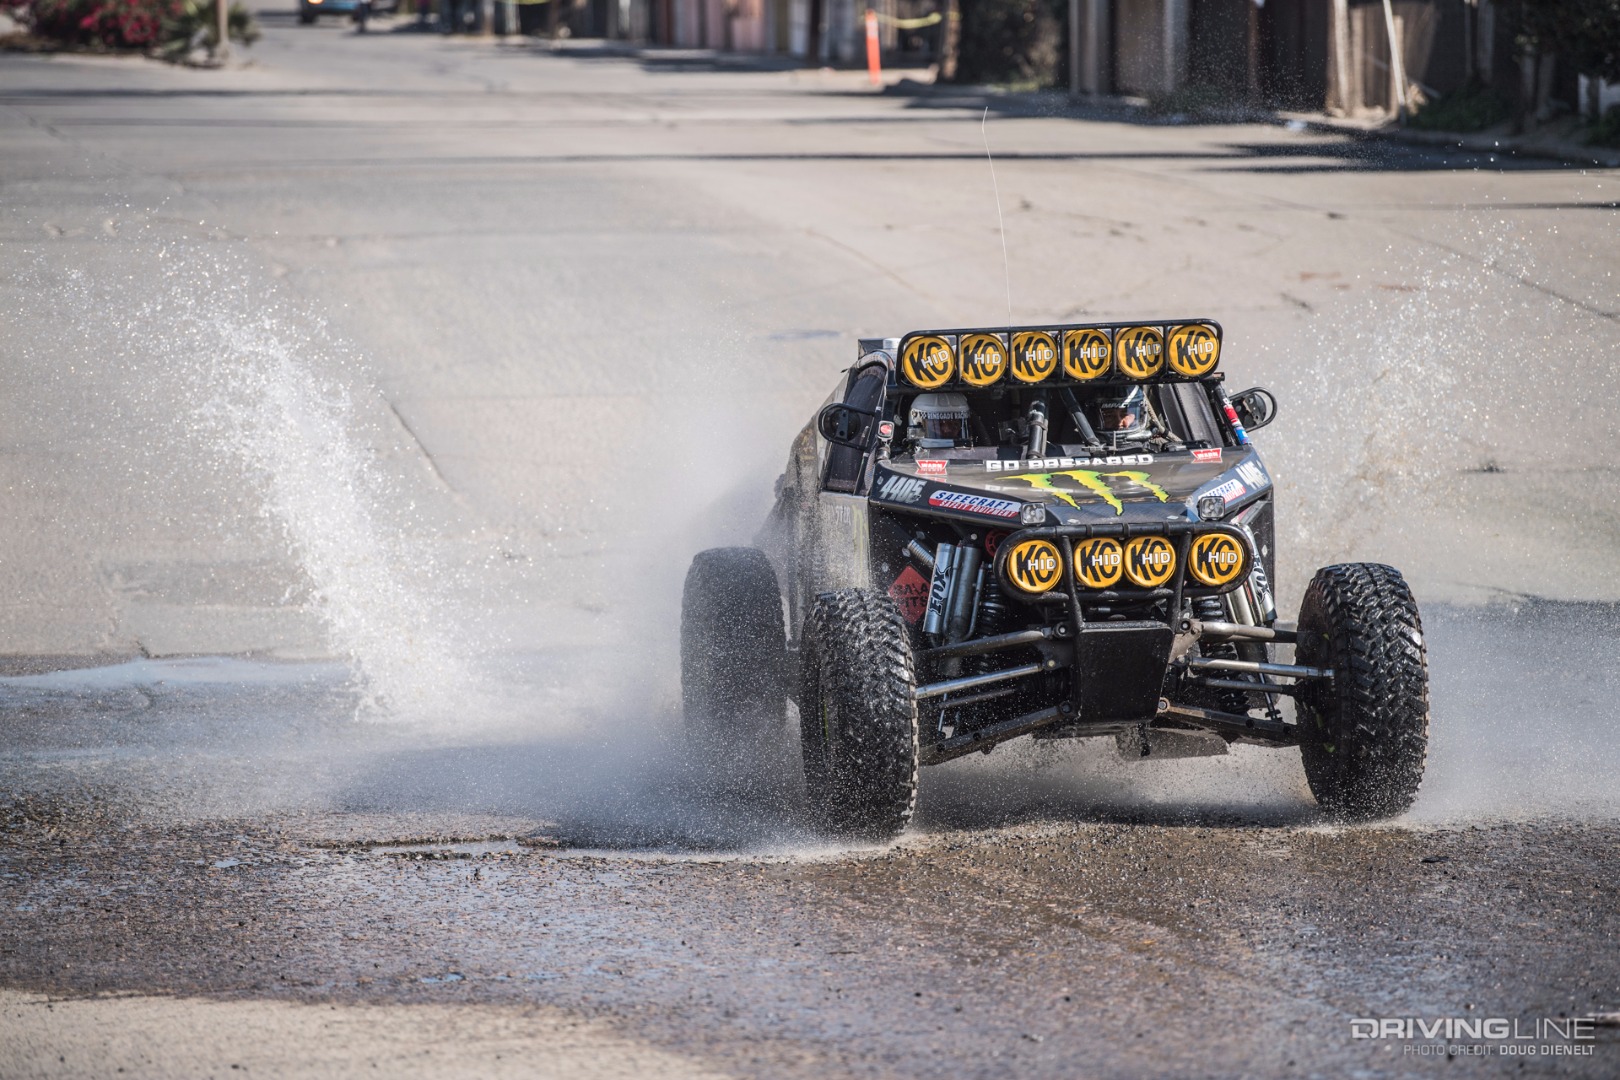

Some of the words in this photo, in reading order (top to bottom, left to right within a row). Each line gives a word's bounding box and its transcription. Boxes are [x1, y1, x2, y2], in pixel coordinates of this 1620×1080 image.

[1014, 336, 1050, 377] KC
[1025, 349, 1053, 361] HID
[1069, 333, 1104, 373] KC
[1080, 346, 1108, 359] HID
[1124, 331, 1159, 372] KC
[1135, 343, 1162, 357] HID
[1176, 330, 1211, 370] KC
[1187, 341, 1214, 355] HID
[909, 341, 948, 382] KC
[921, 350, 949, 369] HID
[963, 339, 999, 379] KC
[974, 351, 1002, 365] HID
[986, 459, 1019, 472] GO
[878, 474, 928, 504] 4405
[936, 491, 1013, 510] SAFECRAFT
[939, 500, 971, 512] SAFETY
[970, 504, 1017, 518] EQUIPMENT
[1016, 544, 1054, 587] KC
[1027, 558, 1057, 572] HID
[1081, 540, 1117, 582] KC
[1091, 553, 1121, 567] HID
[1131, 538, 1167, 582] KC
[1141, 552, 1171, 565] HID
[1197, 537, 1234, 579] KC
[1208, 551, 1237, 564] HID
[928, 563, 951, 617] FOX
